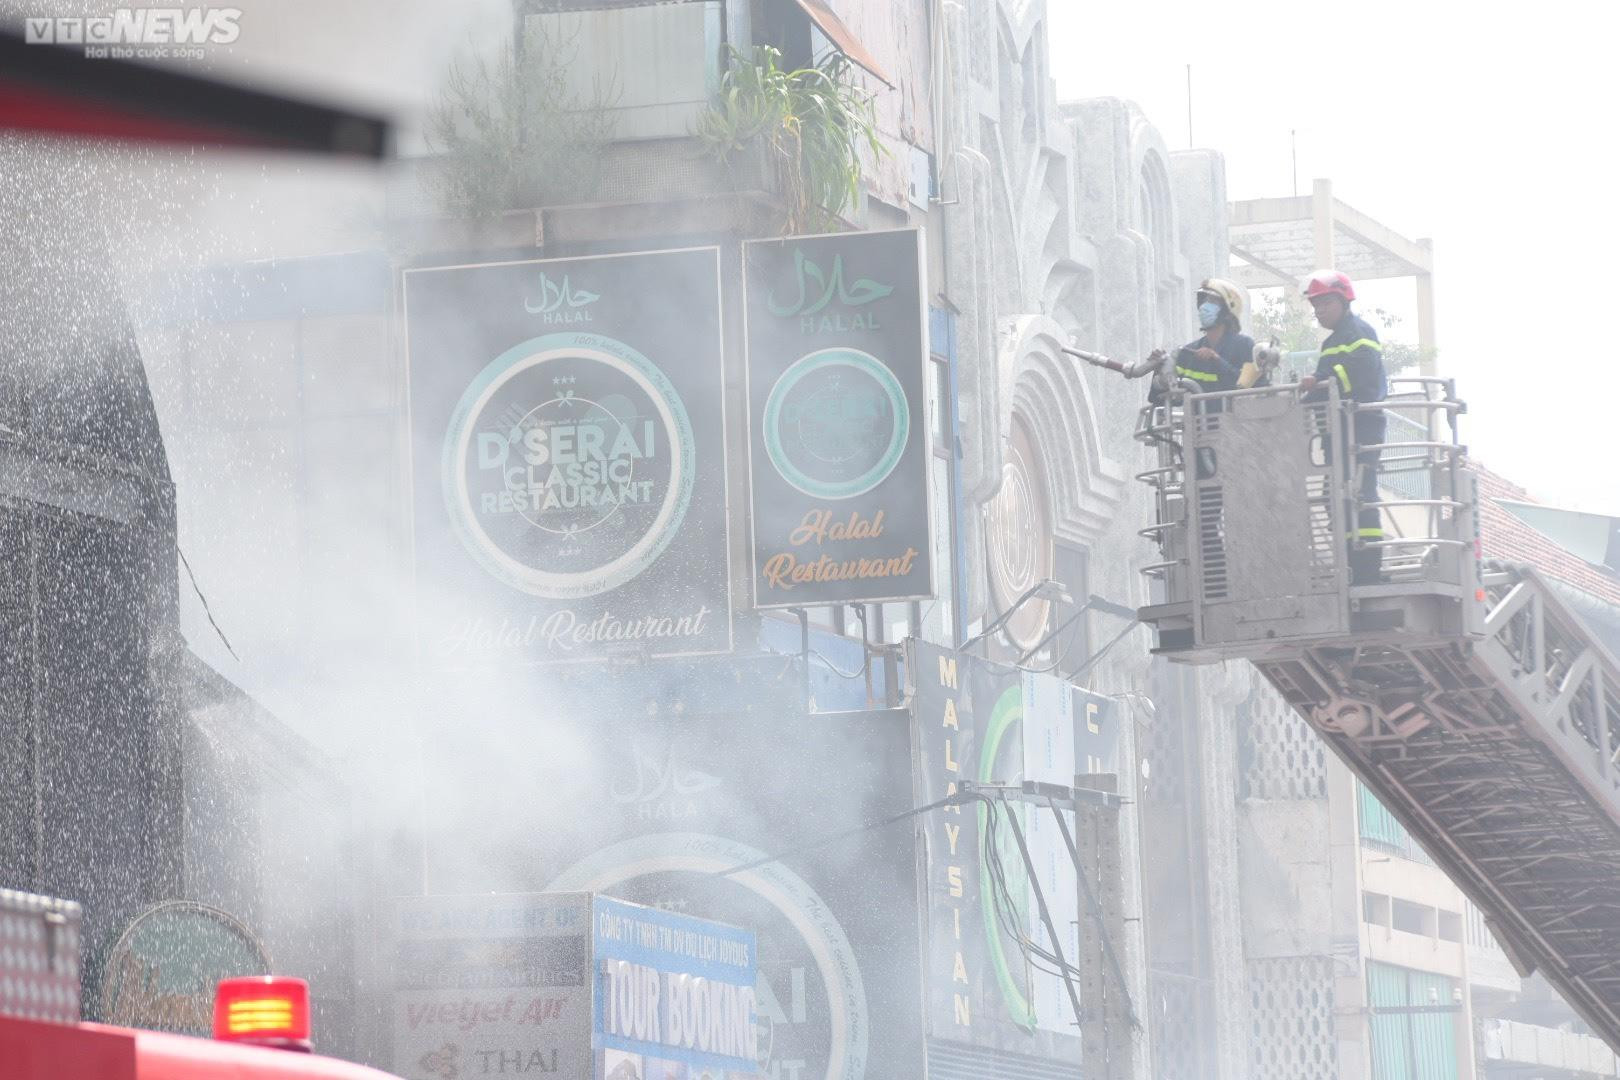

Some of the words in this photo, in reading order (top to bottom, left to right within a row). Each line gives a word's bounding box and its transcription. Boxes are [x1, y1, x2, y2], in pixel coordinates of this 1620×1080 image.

[543, 310, 594, 325] HALAL
[801, 311, 881, 334] HALAL
[505, 458, 631, 491] CLASSIC
[480, 480, 654, 514] RESTAURANT
[789, 508, 885, 546] Halal
[762, 547, 918, 589] Restaurant
[540, 604, 708, 651] Restaurant
[938, 655, 970, 1026] MALAYSIAN
[623, 918, 634, 943] TY
[606, 957, 662, 1043] TOUR
[667, 971, 758, 1061] BOOKING
[474, 1047, 560, 1074] THAI
